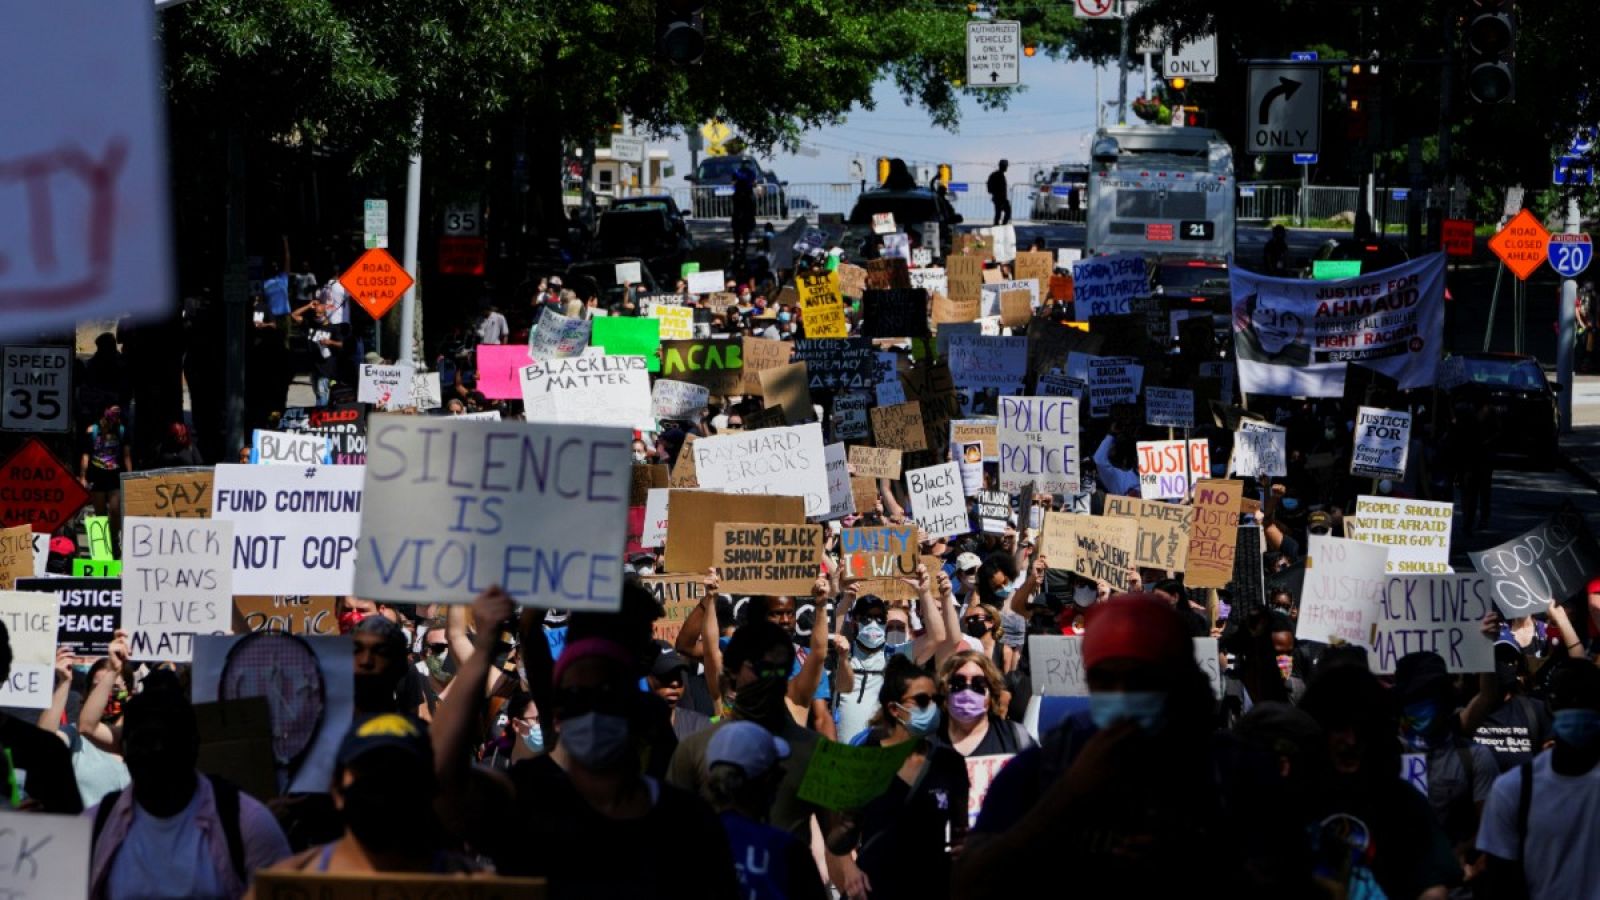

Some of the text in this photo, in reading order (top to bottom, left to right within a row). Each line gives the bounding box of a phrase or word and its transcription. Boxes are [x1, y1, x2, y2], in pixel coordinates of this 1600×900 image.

[1170, 60, 1210, 73] ONLY
[1255, 130, 1309, 147] ONLY
[1195, 182, 1221, 193] 1907
[447, 213, 476, 231] 35
[1189, 224, 1205, 236] 21
[1510, 228, 1537, 237] ROAD
[1504, 240, 1542, 249] CLOSED
[1507, 252, 1540, 261] AHEAD
[1557, 247, 1584, 271] 20
[362, 263, 392, 272] ROAD
[356, 276, 398, 286] CLOSED
[1316, 274, 1419, 300] JUSTICE FOR
[359, 289, 395, 299] AHEAD
[1315, 288, 1419, 318] AHMAUD
[1363, 318, 1379, 330] ALL
[796, 338, 851, 351] WITCHES
[1315, 324, 1418, 348] FIGHT RACISM
[7, 355, 66, 370] SPEED
[526, 356, 647, 381] BLACK LIVES
[664, 344, 744, 375] ACAB
[12, 372, 59, 386] LIMIT
[364, 365, 401, 377] ENOUGH
[546, 373, 631, 393] MATTER
[8, 389, 62, 421] 35
[309, 407, 361, 427] KILLED
[1002, 398, 1073, 435] POLICE
[1359, 413, 1409, 429] JUSTICE
[1024, 432, 1042, 442] THE
[1365, 425, 1401, 441] FOR
[260, 434, 325, 464] BLACK
[697, 431, 801, 469] RAYSHARD
[1355, 453, 1381, 463] Floyd
[1356, 443, 1390, 456] George
[370, 423, 627, 503] SILENCE
[725, 448, 811, 483] BROOKS
[1002, 443, 1075, 475] POLICE
[1137, 443, 1210, 474] JUSTCE
[9, 466, 56, 480] ROAD
[304, 467, 317, 479] #
[910, 467, 956, 494] Black
[1140, 474, 1157, 485] FOR
[1, 487, 65, 502] CLOSED
[154, 481, 209, 509] SAY
[216, 490, 267, 513] FUND
[275, 490, 361, 513] COMMUNI
[1200, 488, 1229, 506] NO
[3, 508, 60, 523] AHEAD
[448, 495, 504, 536] IS
[1107, 499, 1183, 523] ALL LIVES
[1357, 500, 1452, 517] PEOPLE SHOULD
[914, 513, 968, 534] Matter!
[1355, 517, 1448, 532] NOT BE AFRAID
[132, 524, 220, 558] BLACK
[725, 527, 819, 546] BEING BLACK
[841, 529, 911, 552] UNITY
[1195, 526, 1222, 540] NO
[1370, 533, 1408, 546] THEIR
[232, 535, 286, 569] NOT
[799, 550, 815, 564] BE
[1319, 543, 1347, 564] NO
[1481, 535, 1545, 577] GOOD
[369, 536, 620, 603] VIOLENCE
[725, 566, 762, 581] DEATH
[764, 564, 821, 581] SENTENCE
[1397, 561, 1447, 573] SHOULD
[1495, 535, 1587, 609] QUIT
[137, 567, 218, 593] TRANS
[1429, 578, 1486, 622] LIVES
[137, 600, 217, 626] LIVES
[58, 614, 115, 632] PEACE
[1372, 627, 1465, 671] MATTER
[1512, 727, 1529, 736] FOR
